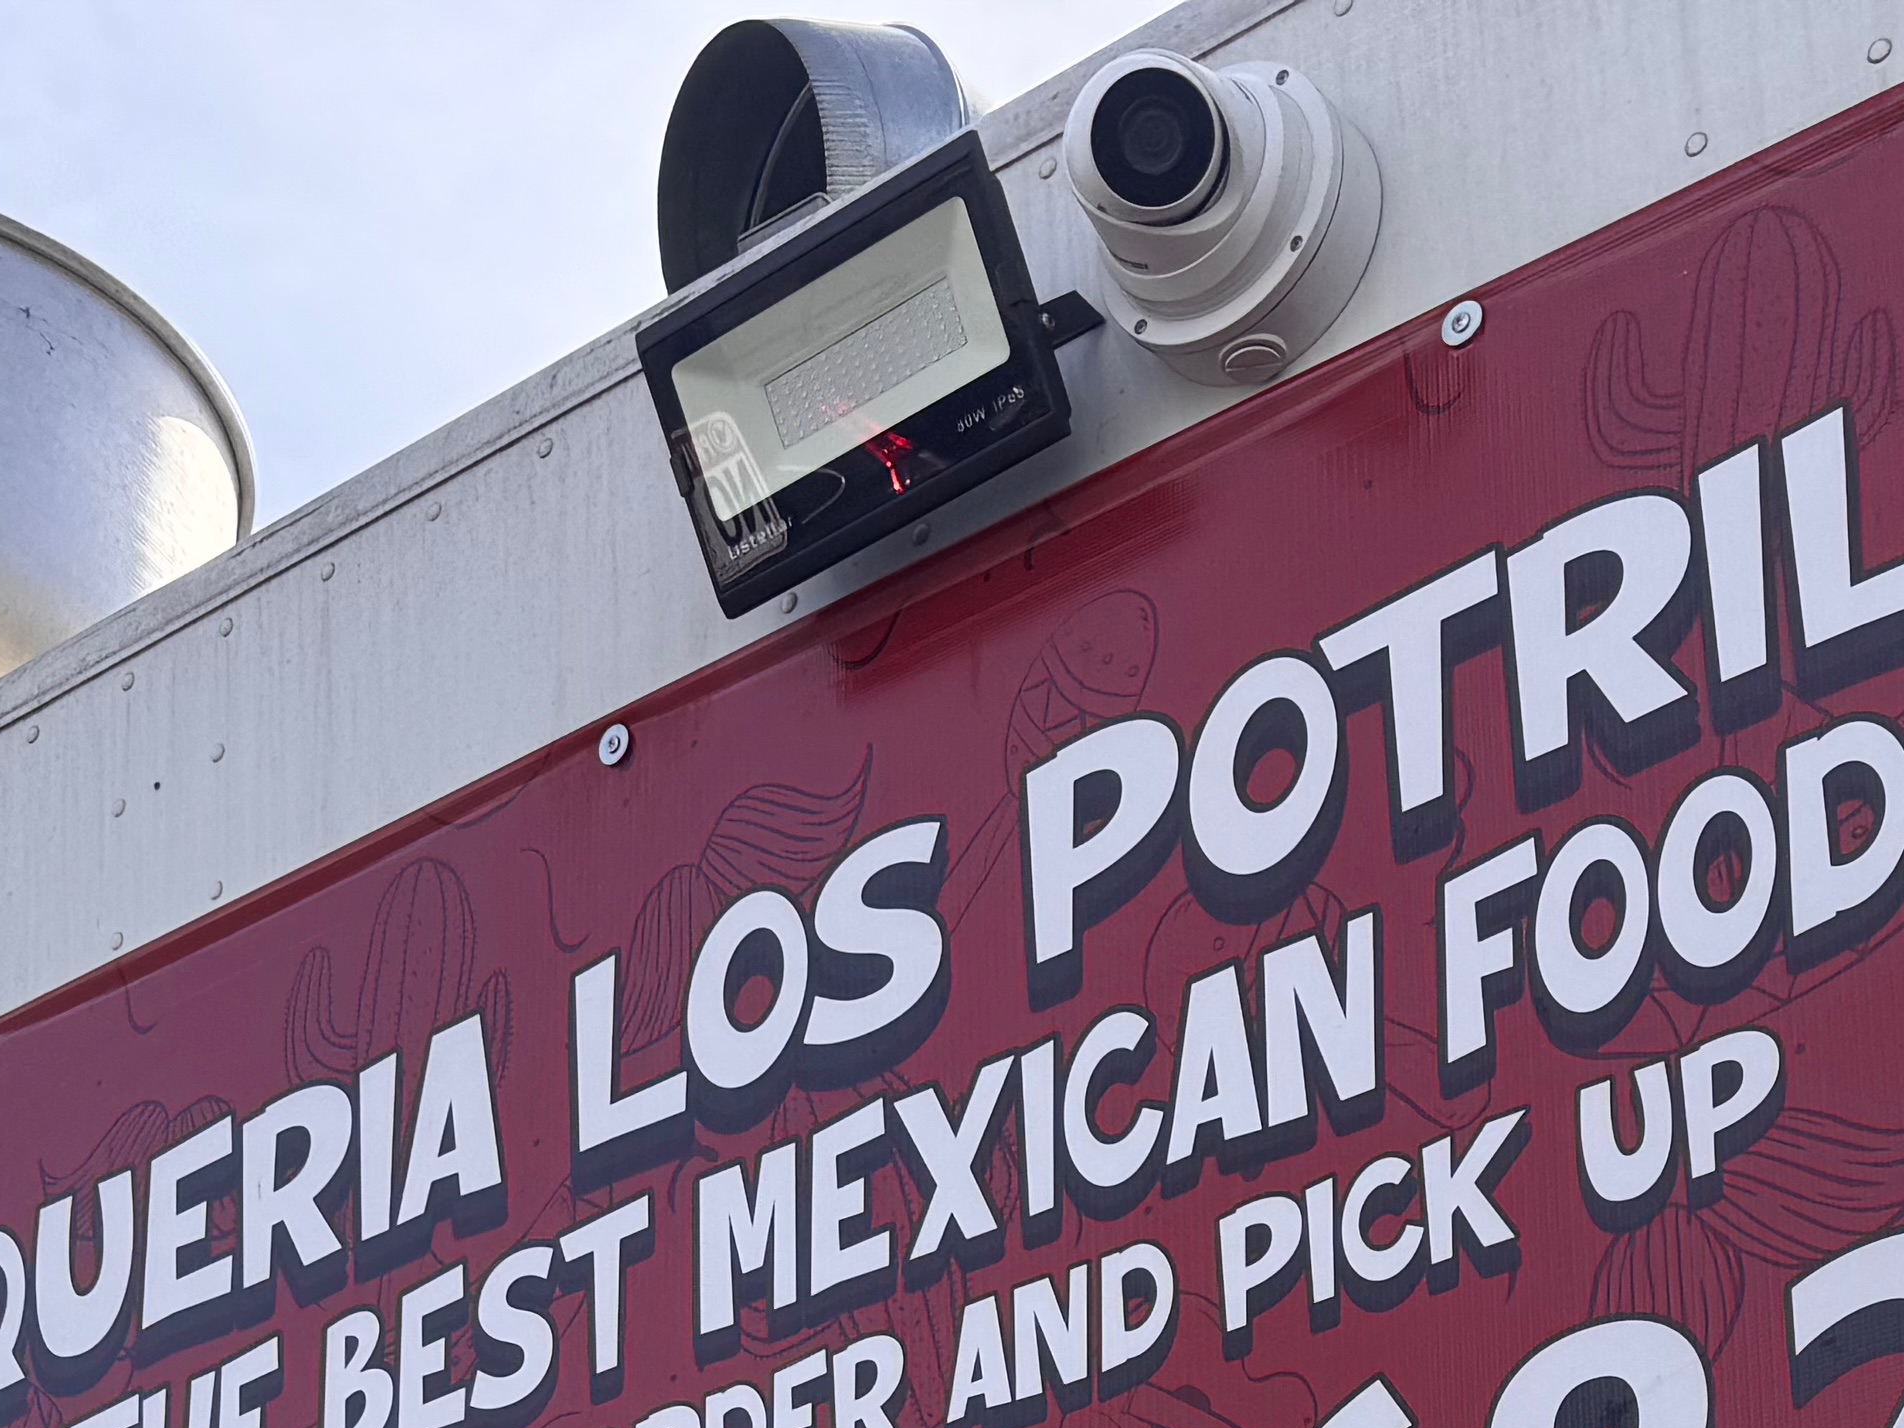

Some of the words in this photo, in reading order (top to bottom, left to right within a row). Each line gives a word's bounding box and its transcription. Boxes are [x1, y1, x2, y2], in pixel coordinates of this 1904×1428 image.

[575, 822, 942, 1151] LOS
[700, 913, 1375, 1333] MEXICAN
[947, 1244, 1173, 1422] AND
[1220, 1111, 1523, 1331] PICK
[1580, 1031, 1779, 1201] UP
